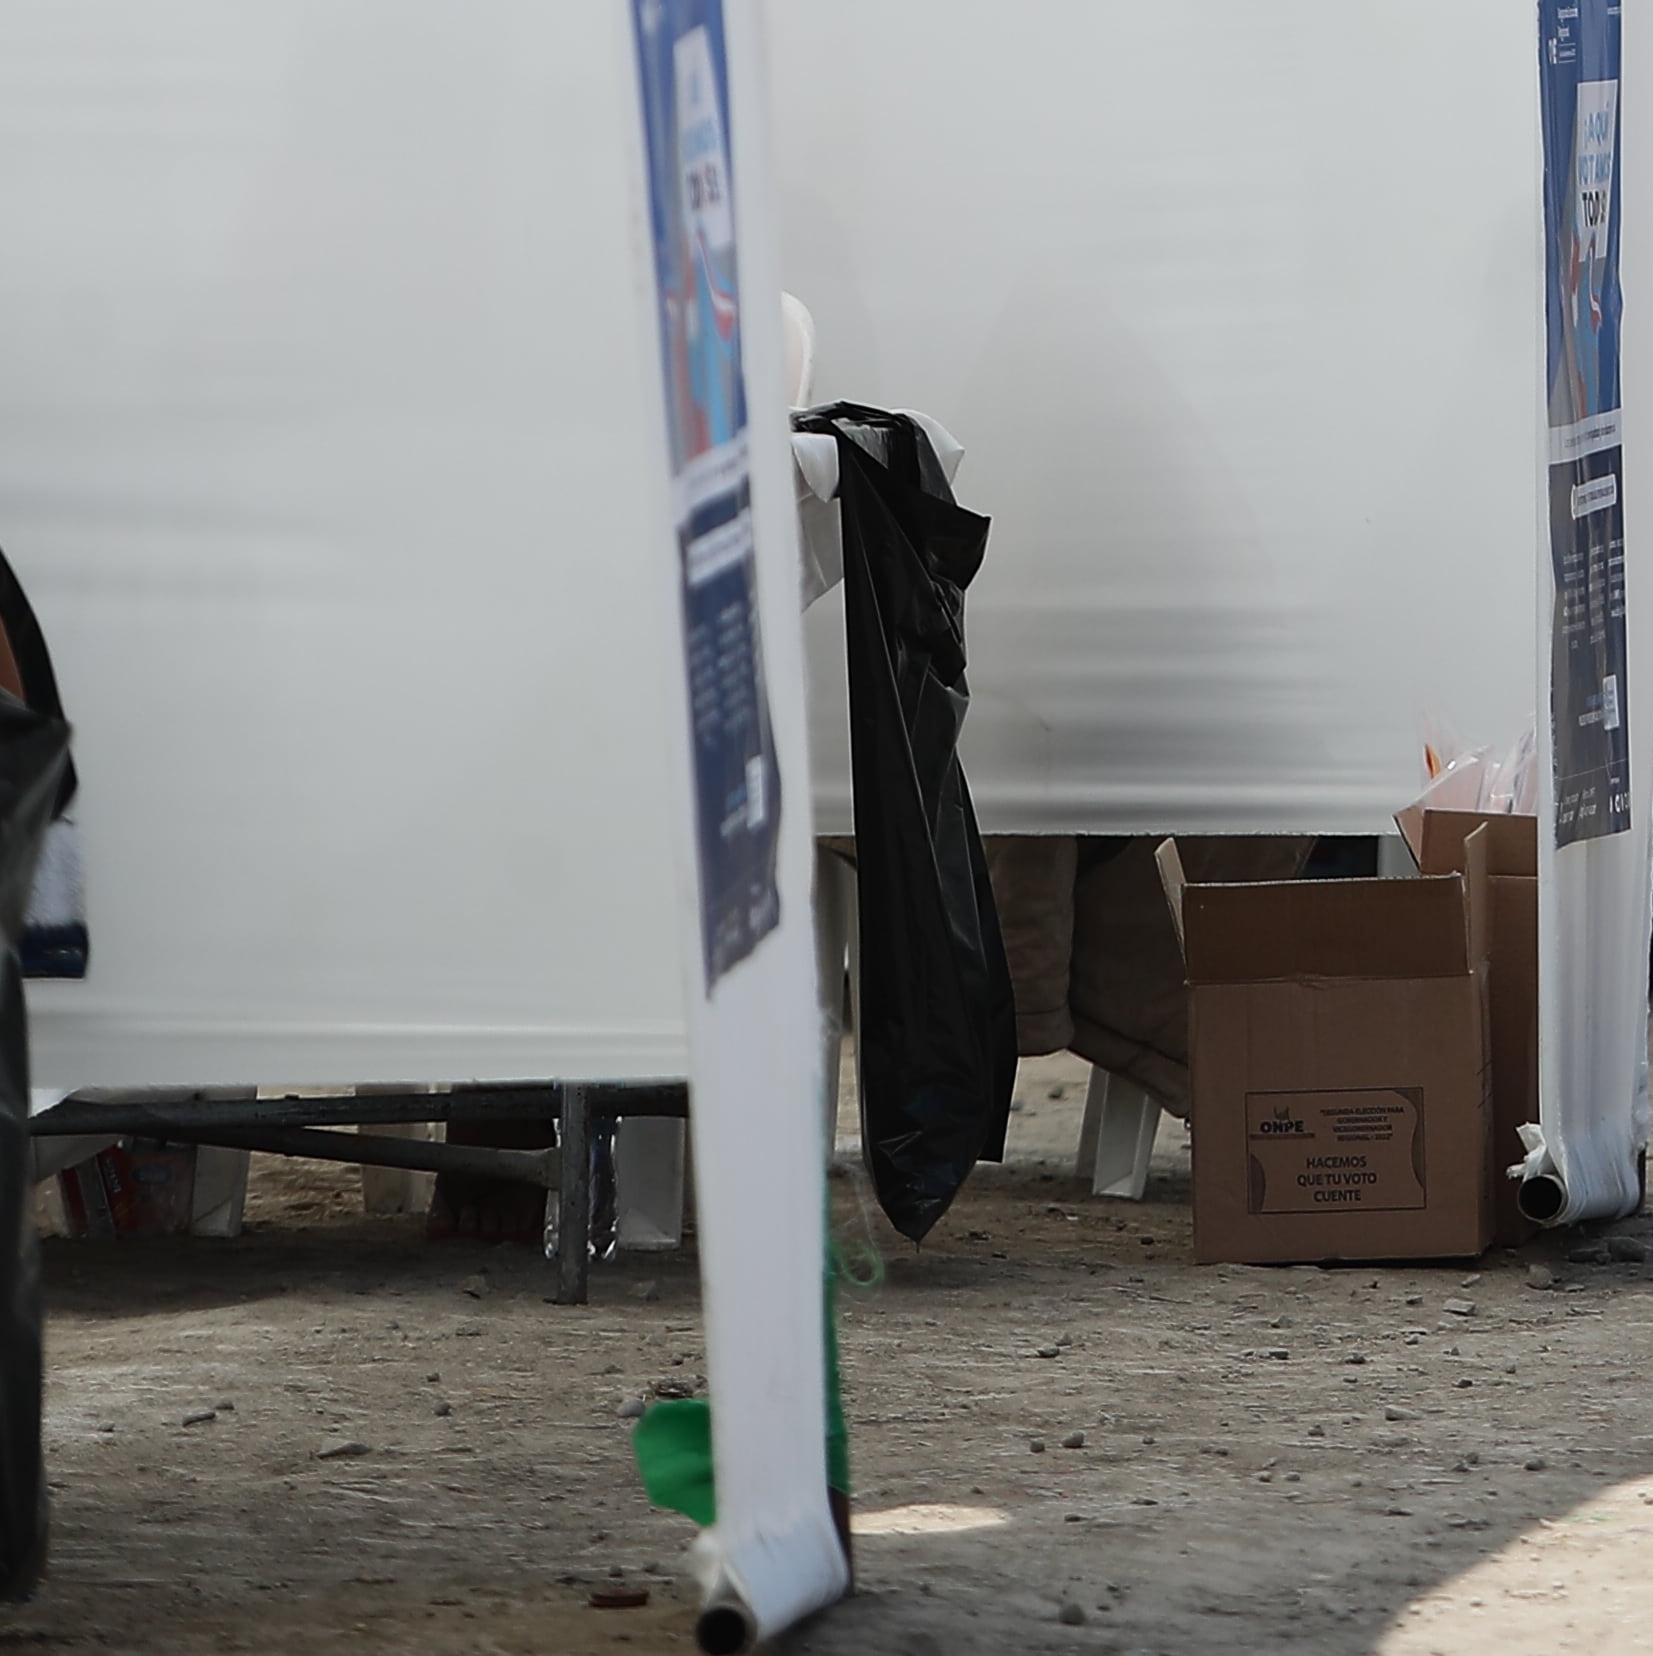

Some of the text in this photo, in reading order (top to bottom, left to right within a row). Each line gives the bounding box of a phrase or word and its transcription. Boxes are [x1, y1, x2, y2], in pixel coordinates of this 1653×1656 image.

[1582, 191, 1606, 227] TODS
[1260, 1120, 1304, 1133] ONPE
[1306, 1156, 1366, 1169] HACEMOS
[1297, 1173, 1377, 1187] QUE TU VOTO
[1314, 1190, 1361, 1203] CUENTE
